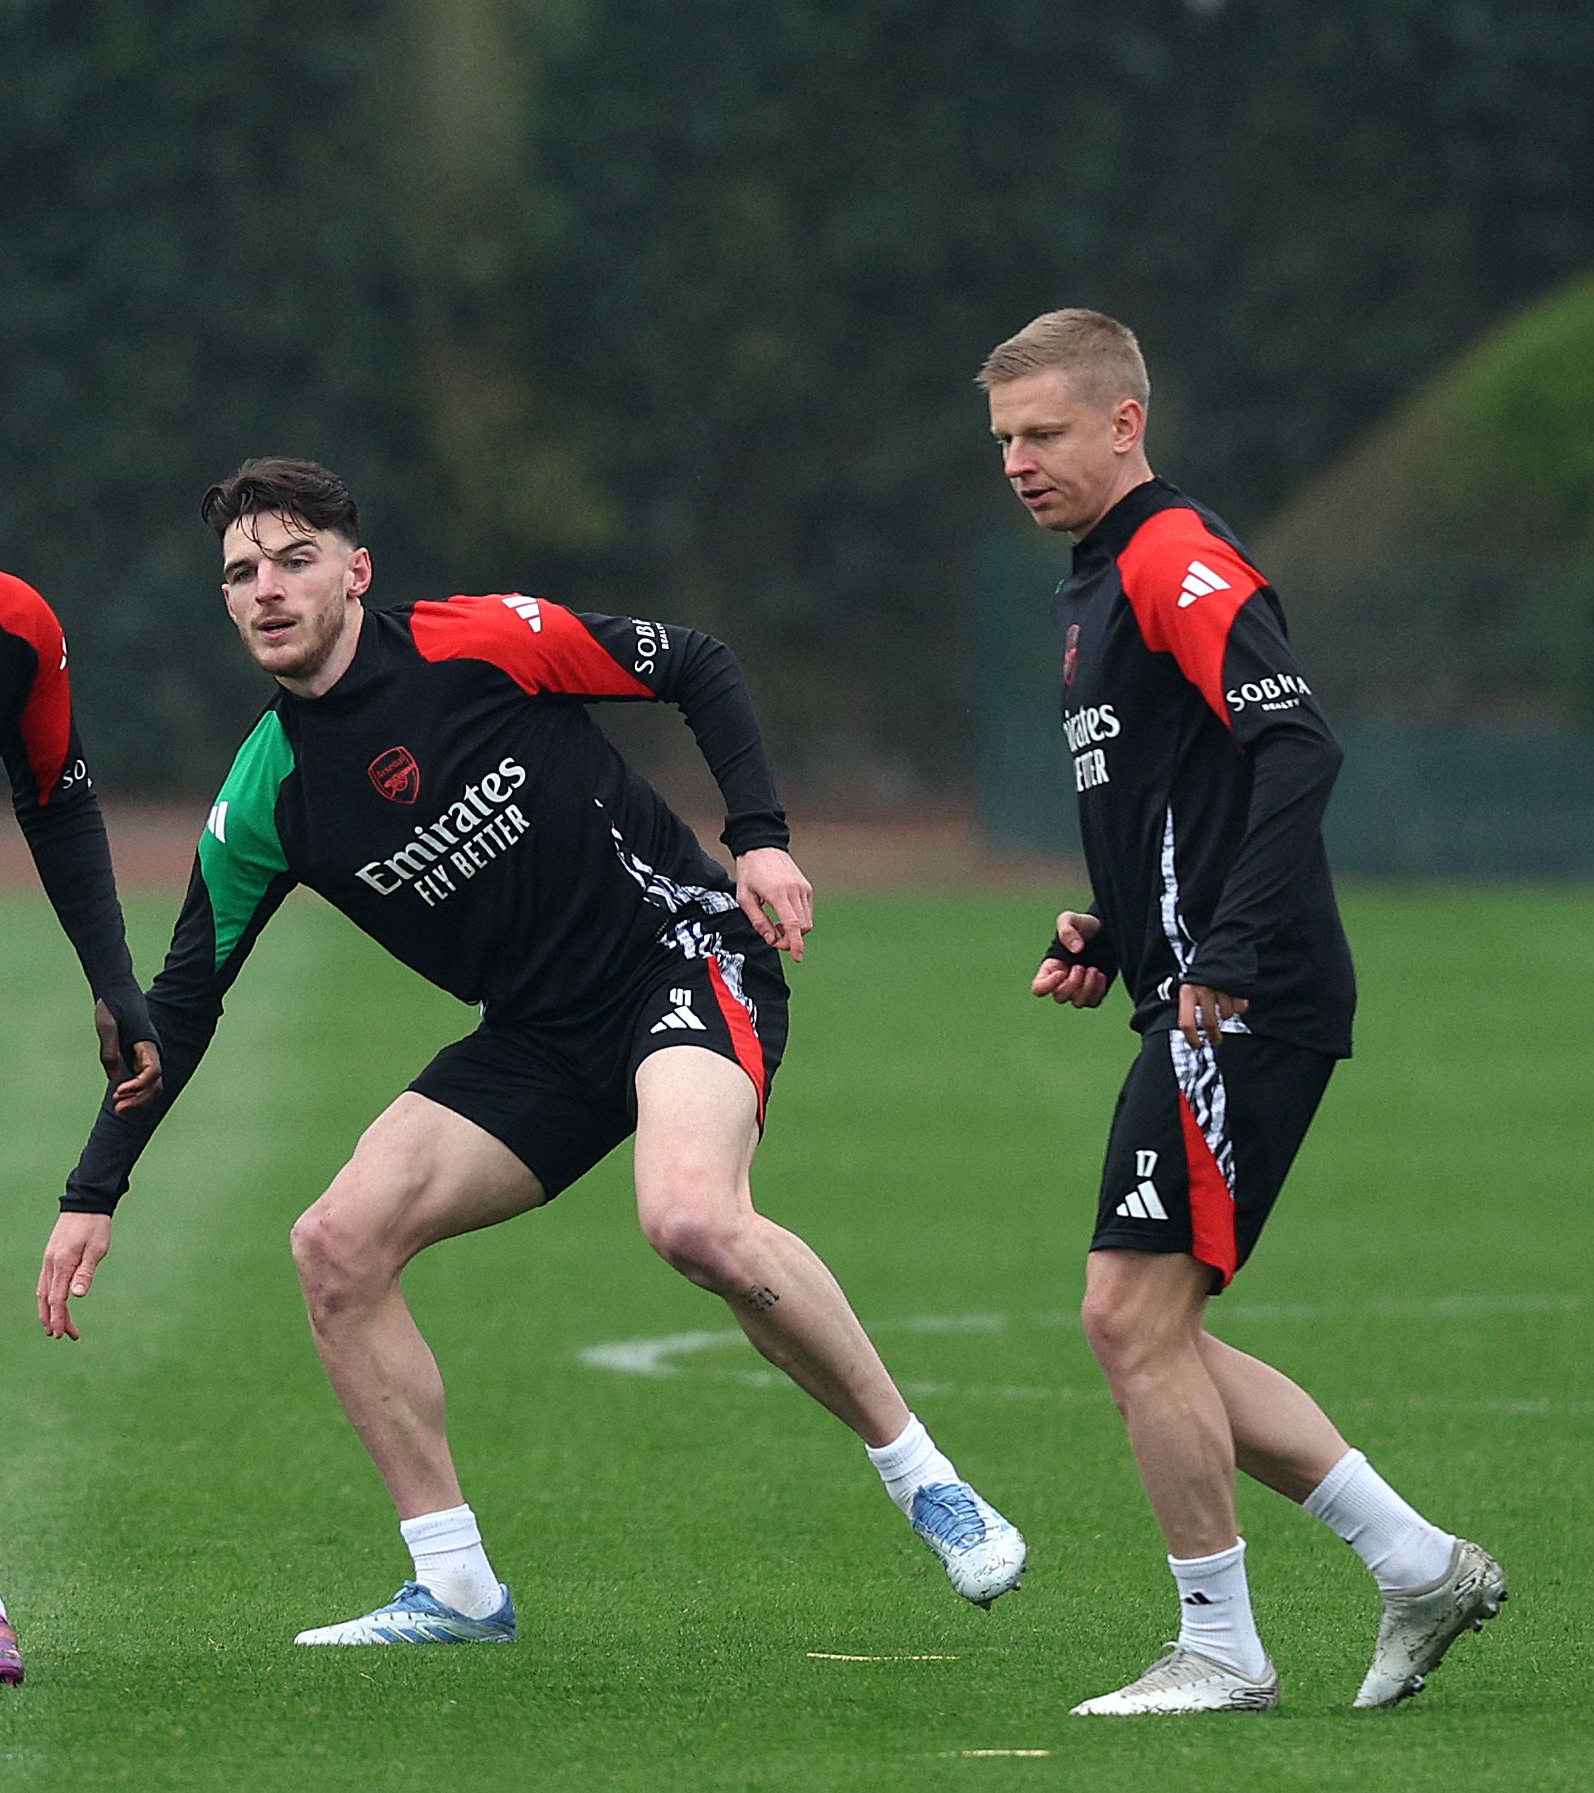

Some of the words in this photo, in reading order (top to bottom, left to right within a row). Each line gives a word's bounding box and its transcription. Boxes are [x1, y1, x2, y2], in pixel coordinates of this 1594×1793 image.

[632, 618, 657, 675] SOB
[355, 757, 526, 895] Emirates
[413, 864, 457, 907] FLY
[450, 804, 531, 879] BETTER
[669, 988, 692, 1007] 41
[1136, 1150, 1158, 1177] 17
